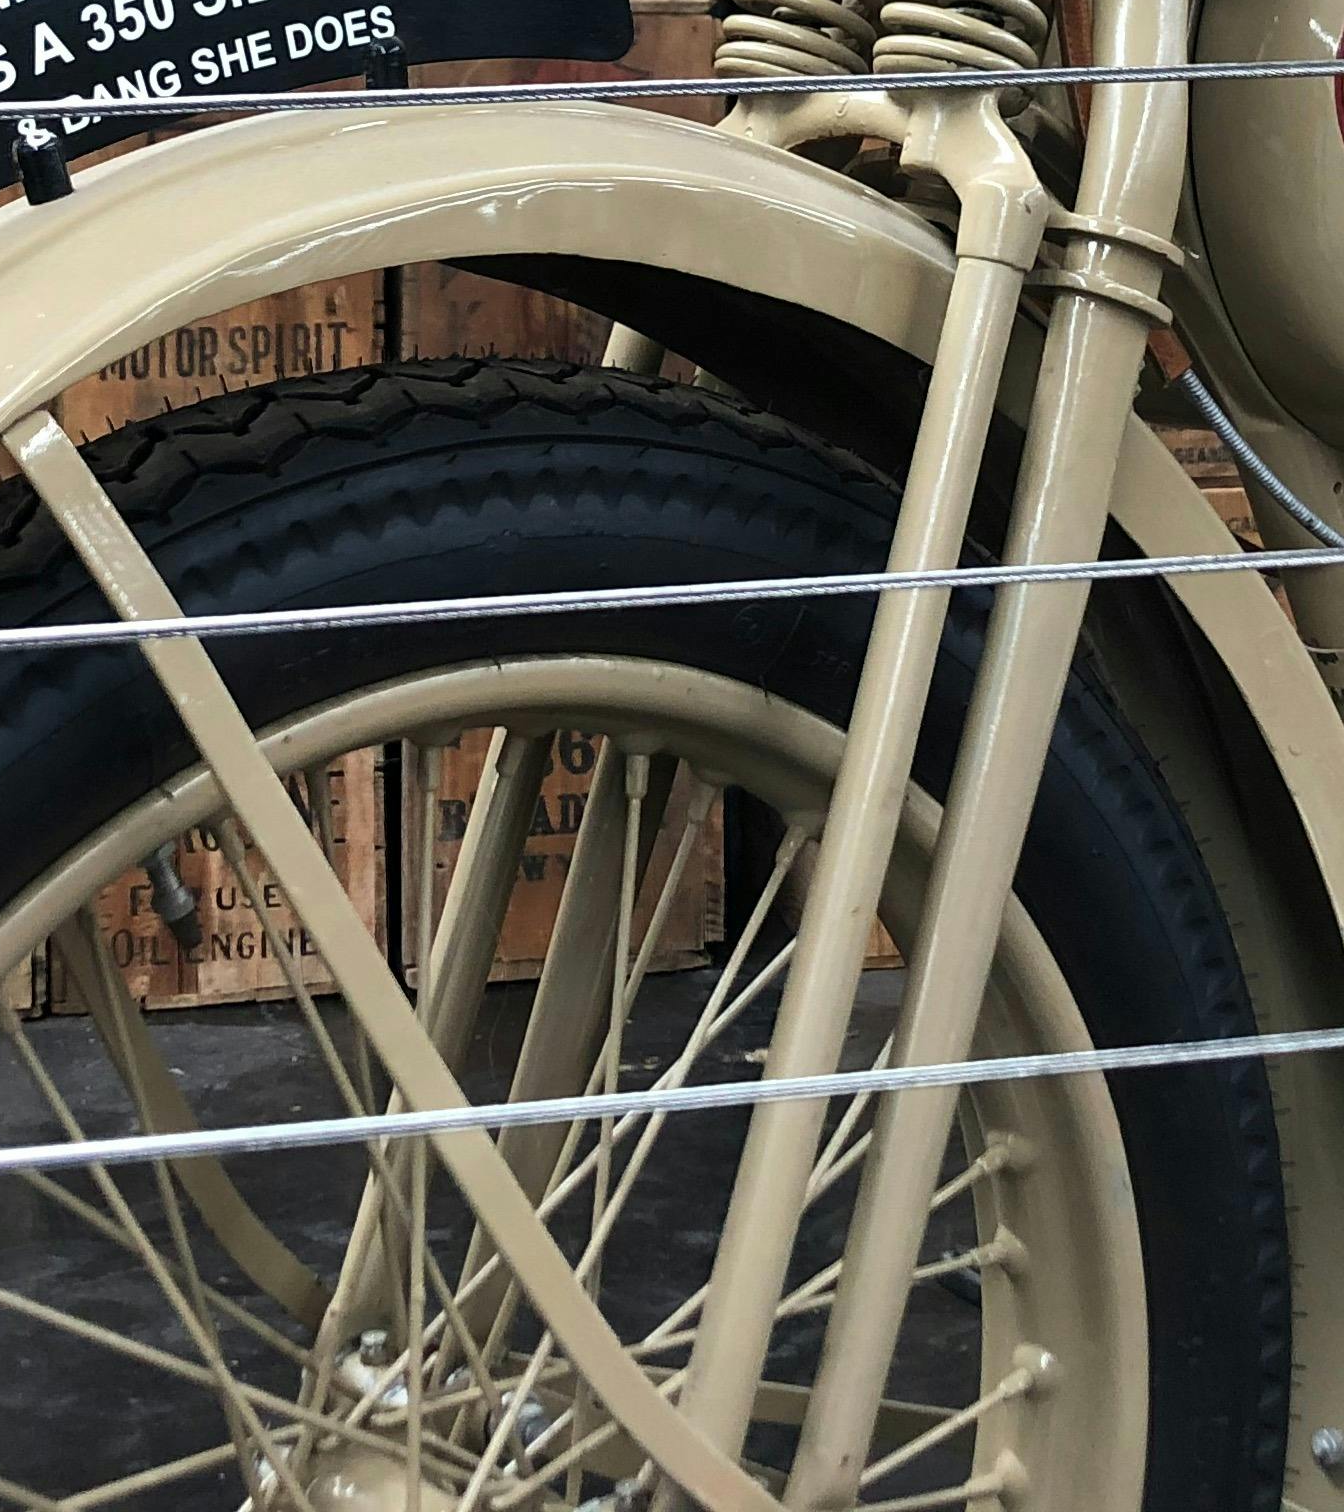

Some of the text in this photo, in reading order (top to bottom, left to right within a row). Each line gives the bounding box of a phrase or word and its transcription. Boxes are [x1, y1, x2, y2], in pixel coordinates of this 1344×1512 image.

[32, 23, 75, 77] A
[16, 4, 398, 151] & BANG SHE DOES
[97, 321, 349, 382] MOTOR SPIRIT
[215, 883, 283, 912] USE
[111, 928, 172, 969] OIL
